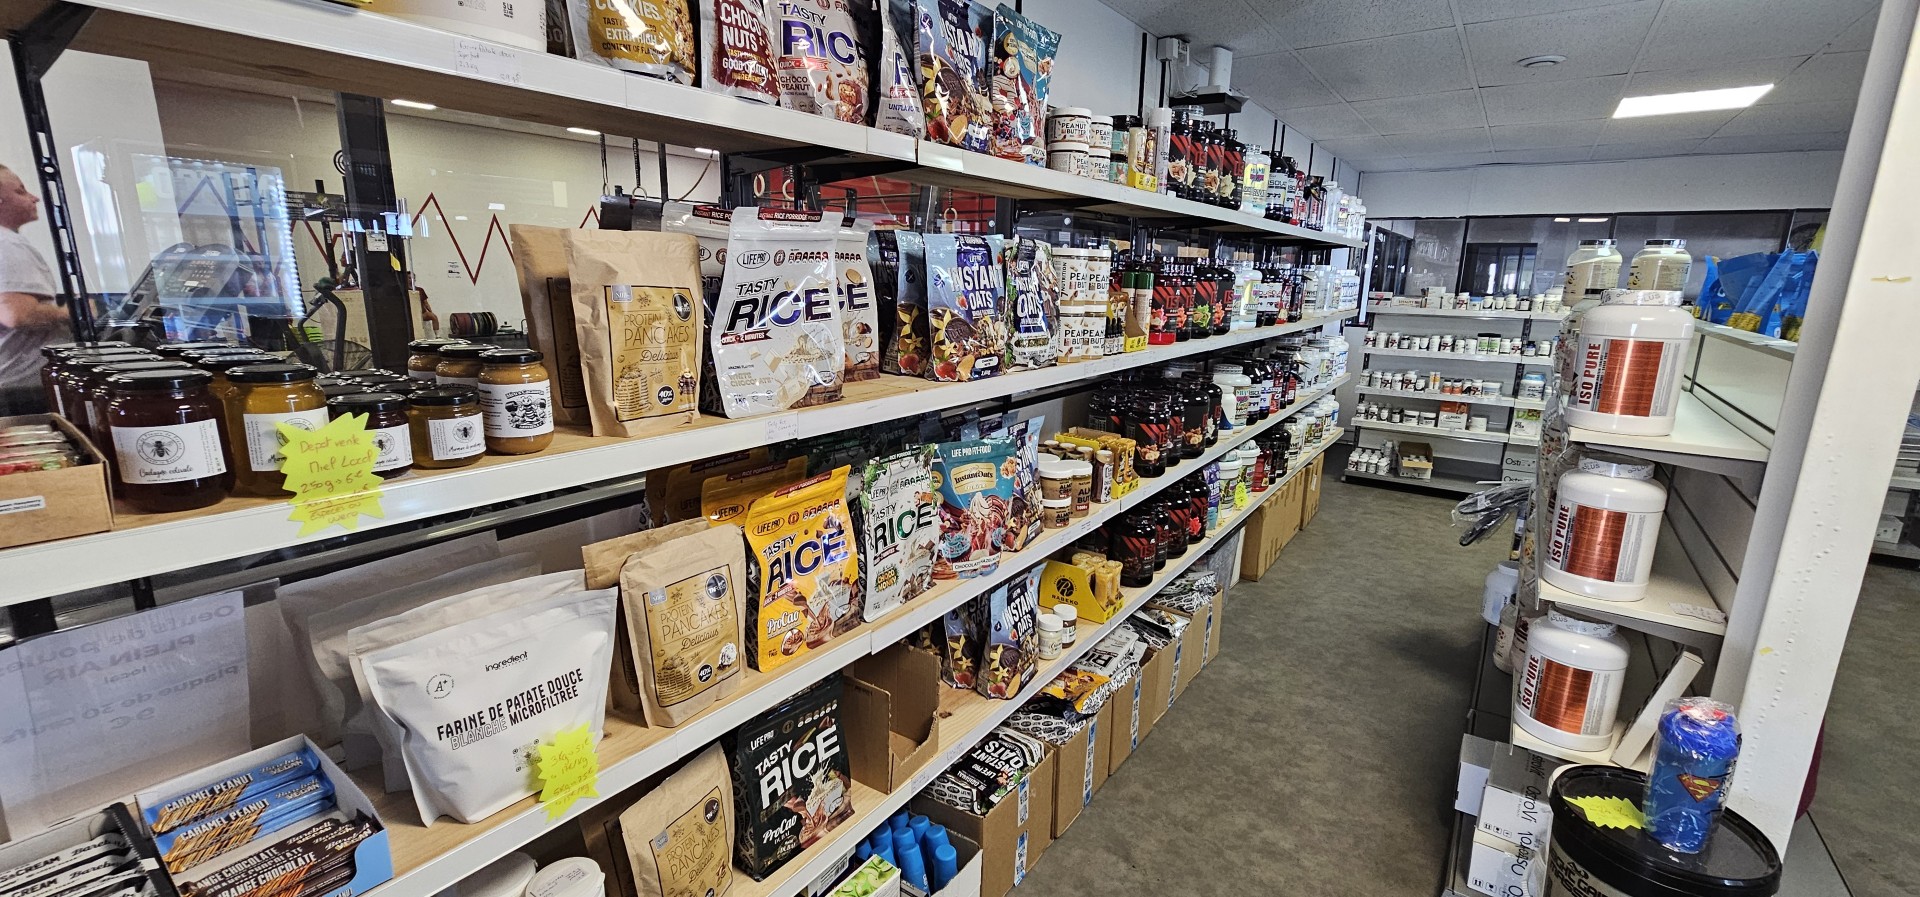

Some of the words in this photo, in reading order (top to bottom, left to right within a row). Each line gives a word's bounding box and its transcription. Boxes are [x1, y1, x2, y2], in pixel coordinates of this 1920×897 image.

[720, 3, 762, 37] CHOCO
[778, 3, 827, 26] TASTY
[722, 26, 758, 52] NUTS
[722, 58, 743, 71] GOOD
[780, 76, 808, 84] CHOCO
[781, 83, 810, 91] PEANUT
[1061, 122, 1086, 131] PEANUT
[785, 213, 808, 221] PORRIDGE
[742, 252, 757, 265] LIFE
[757, 252, 767, 263] PRO
[736, 276, 781, 297] TASTY
[947, 266, 1004, 292] INSTANT
[724, 286, 832, 333] RICE
[969, 290, 994, 310] OATS
[624, 313, 661, 328] PROTEIN
[624, 325, 690, 347] PANCAKES
[745, 331, 765, 340] MINUTES
[1583, 343, 1601, 379] PURE
[728, 373, 752, 381] WHITE
[1578, 381, 1594, 405] ISO
[951, 448, 962, 458] LIFE
[954, 470, 994, 485] InstantOats
[872, 503, 897, 523] TASTY
[1555, 504, 1570, 542] PURE
[756, 523, 772, 534] LIFE
[770, 519, 781, 530] PRO
[873, 502, 933, 556] RICE
[762, 534, 797, 559] TASTY
[1551, 542, 1563, 564] ISO
[766, 528, 849, 596] RICE
[877, 570, 895, 583] CHOCO
[1002, 589, 1038, 630] INSTANT
[1051, 594, 1079, 606] RABEKO
[660, 602, 695, 625] PROTEIN
[661, 601, 729, 642] PANCAKES
[766, 610, 800, 634] ProCao
[1017, 613, 1033, 637] OATS
[680, 628, 719, 652] Delicious
[485, 650, 528, 672] ingredient
[1526, 654, 1541, 688] PURE
[437, 710, 486, 741] FARINE
[488, 703, 504, 721] DE
[506, 684, 545, 714] PATATE
[547, 668, 584, 695] DOUCE
[1521, 689, 1534, 711] ISO
[450, 716, 508, 751] BLANCHE
[508, 685, 579, 727] MICROFILTREE
[750, 735, 764, 751] LIFE
[763, 729, 775, 743] PRO
[755, 739, 793, 776] TASTY
[971, 749, 1018, 777] INSTANT
[984, 740, 1024, 769] OATS
[760, 724, 841, 810] RICE
[982, 768, 997, 779] LIFE
[165, 789, 213, 813] CARAMEL
[213, 773, 254, 795] PEANUT
[180, 816, 228, 842] CARAMEL
[229, 797, 271, 821] PEANUT
[762, 815, 797, 844] ProCao
[670, 822, 720, 881] PANCAKES
[196, 873, 222, 890] ANGE
[221, 846, 280, 882] CHOCOLATE
[257, 851, 317, 886] CHOCOLATE
